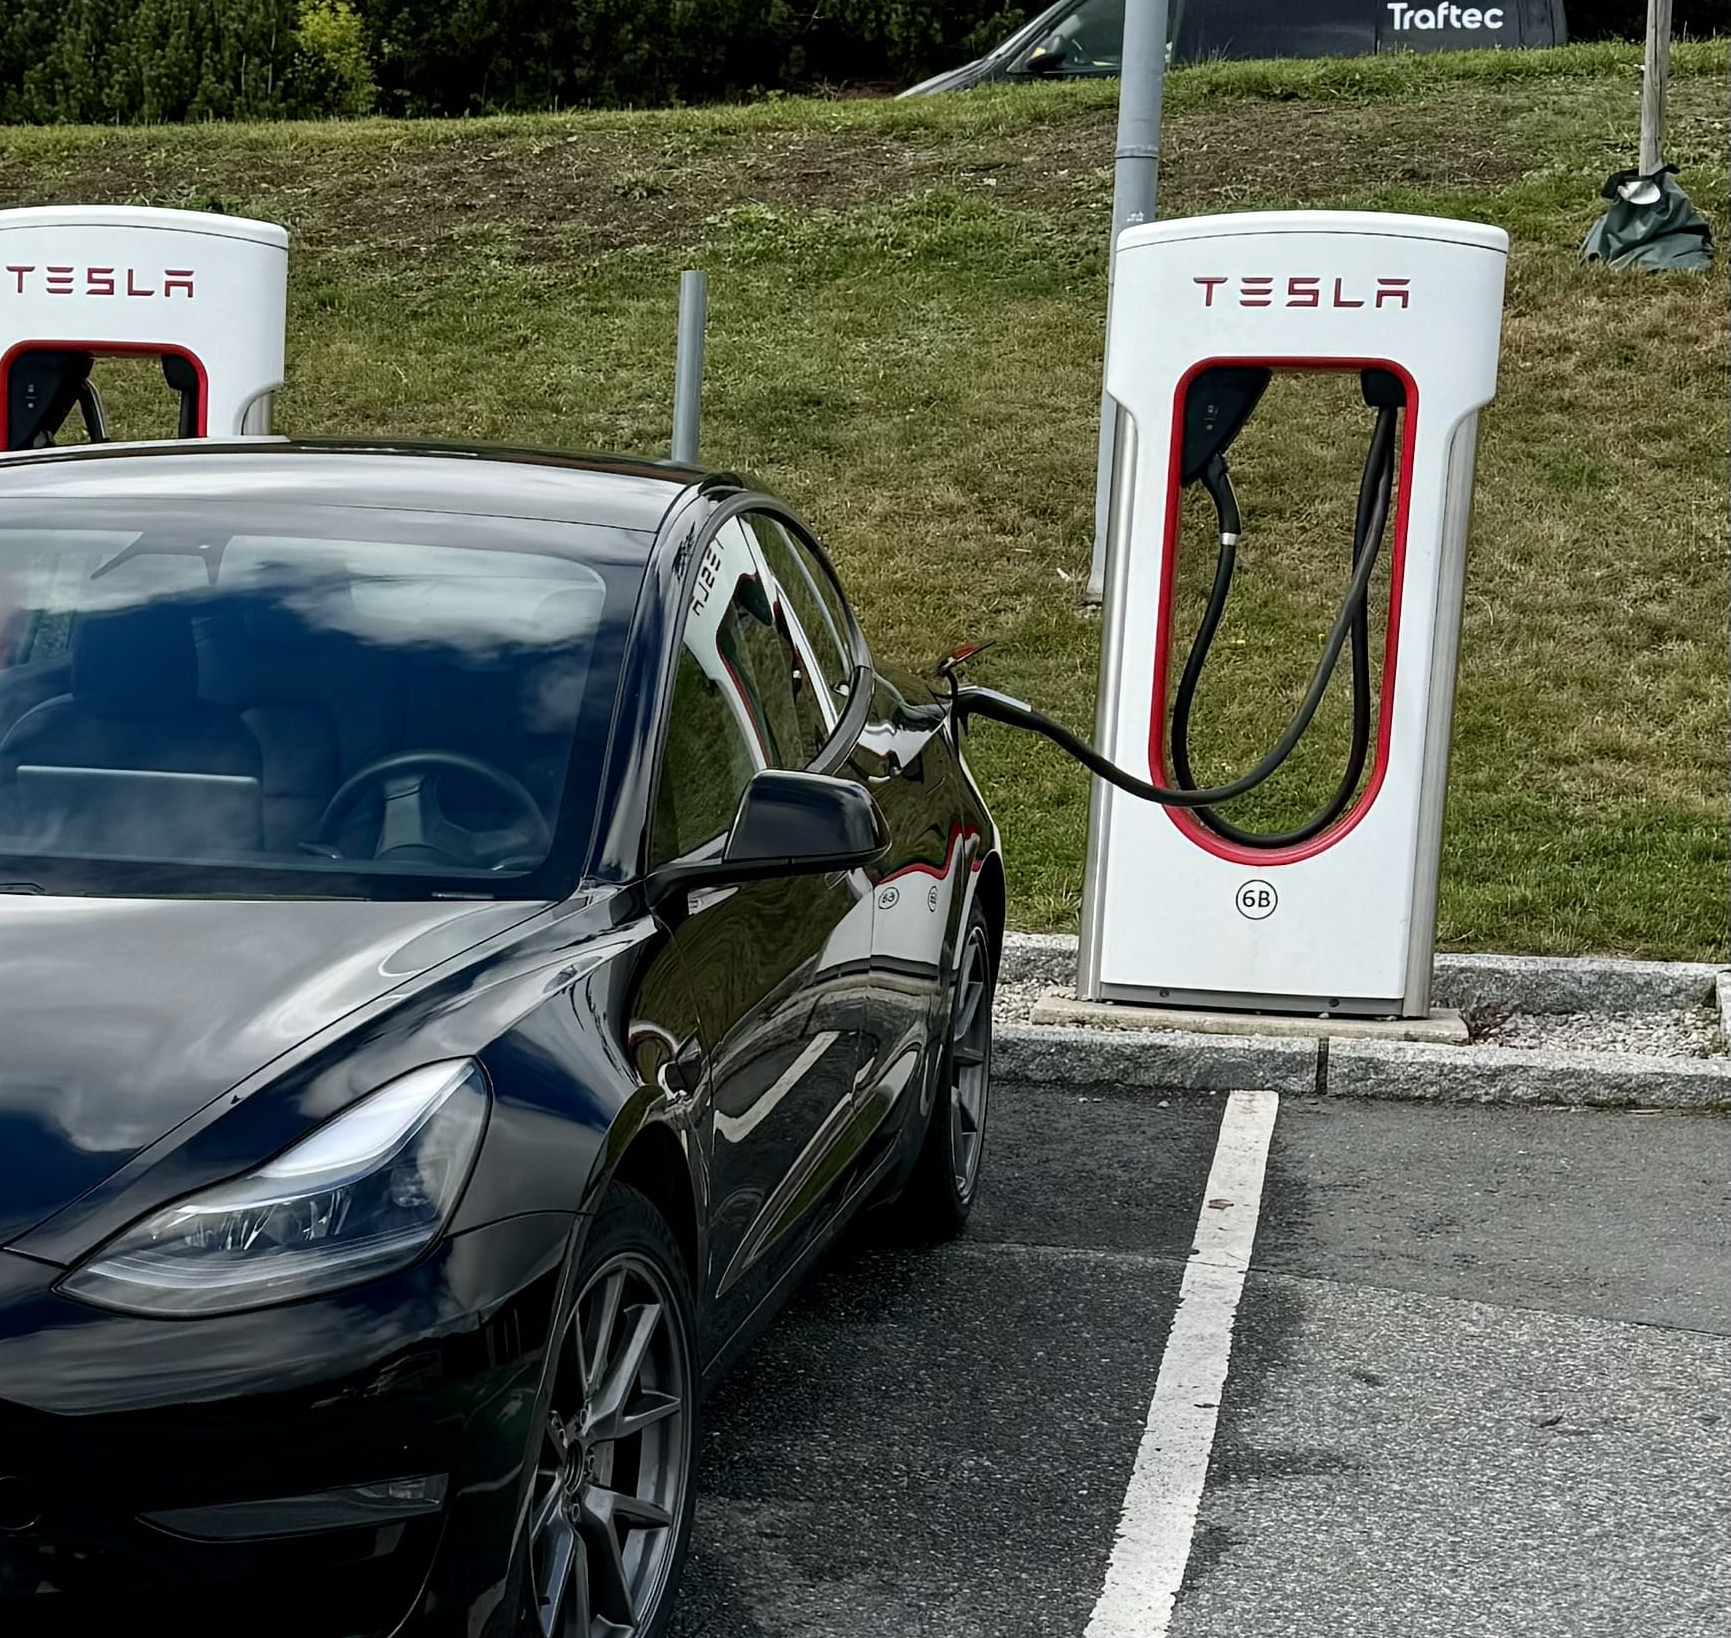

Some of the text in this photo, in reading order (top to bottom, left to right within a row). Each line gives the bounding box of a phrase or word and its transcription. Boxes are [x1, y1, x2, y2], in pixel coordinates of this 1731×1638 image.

[1387, 1, 1504, 30] Traftec
[5, 266, 195, 299] TESLA
[1193, 277, 1411, 309] TESLA
[1242, 889, 1271, 908] 6B
